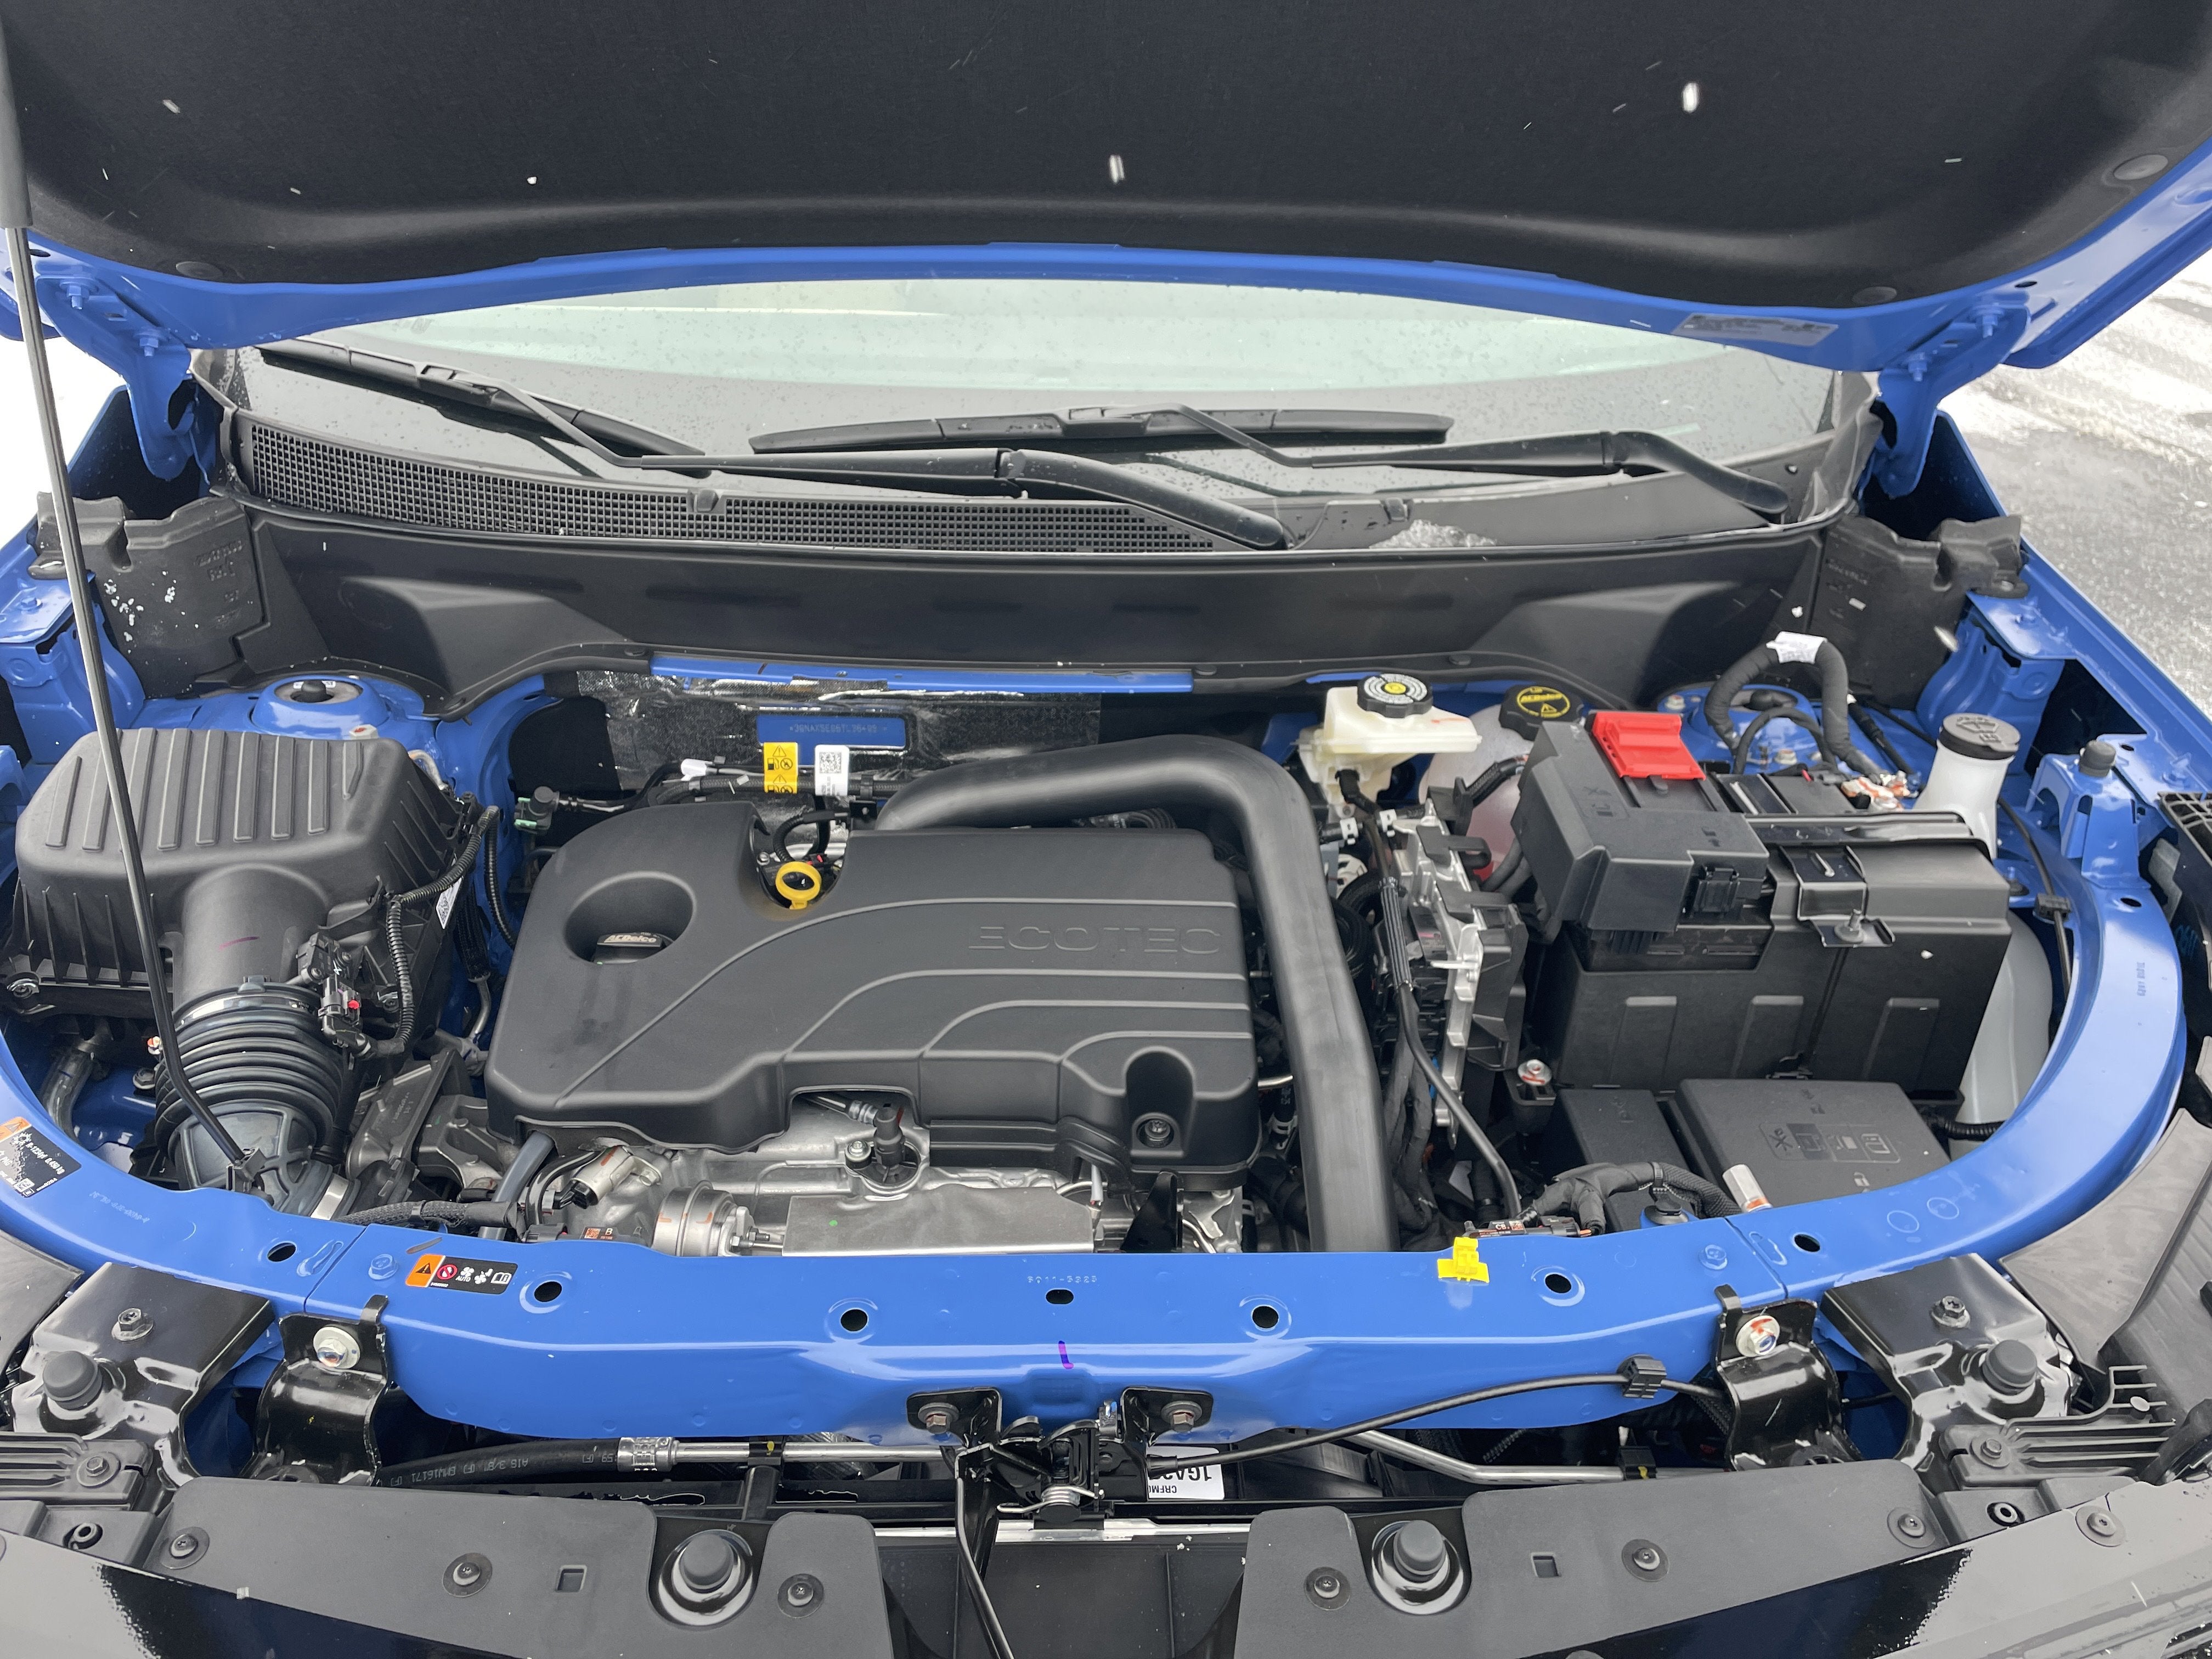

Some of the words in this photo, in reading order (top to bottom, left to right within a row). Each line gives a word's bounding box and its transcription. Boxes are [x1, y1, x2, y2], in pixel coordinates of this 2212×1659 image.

[603, 934, 657, 943] ACDelco
[968, 926, 1221, 954] ECOTEC
[1149, 1465, 1212, 1481] 1GA
